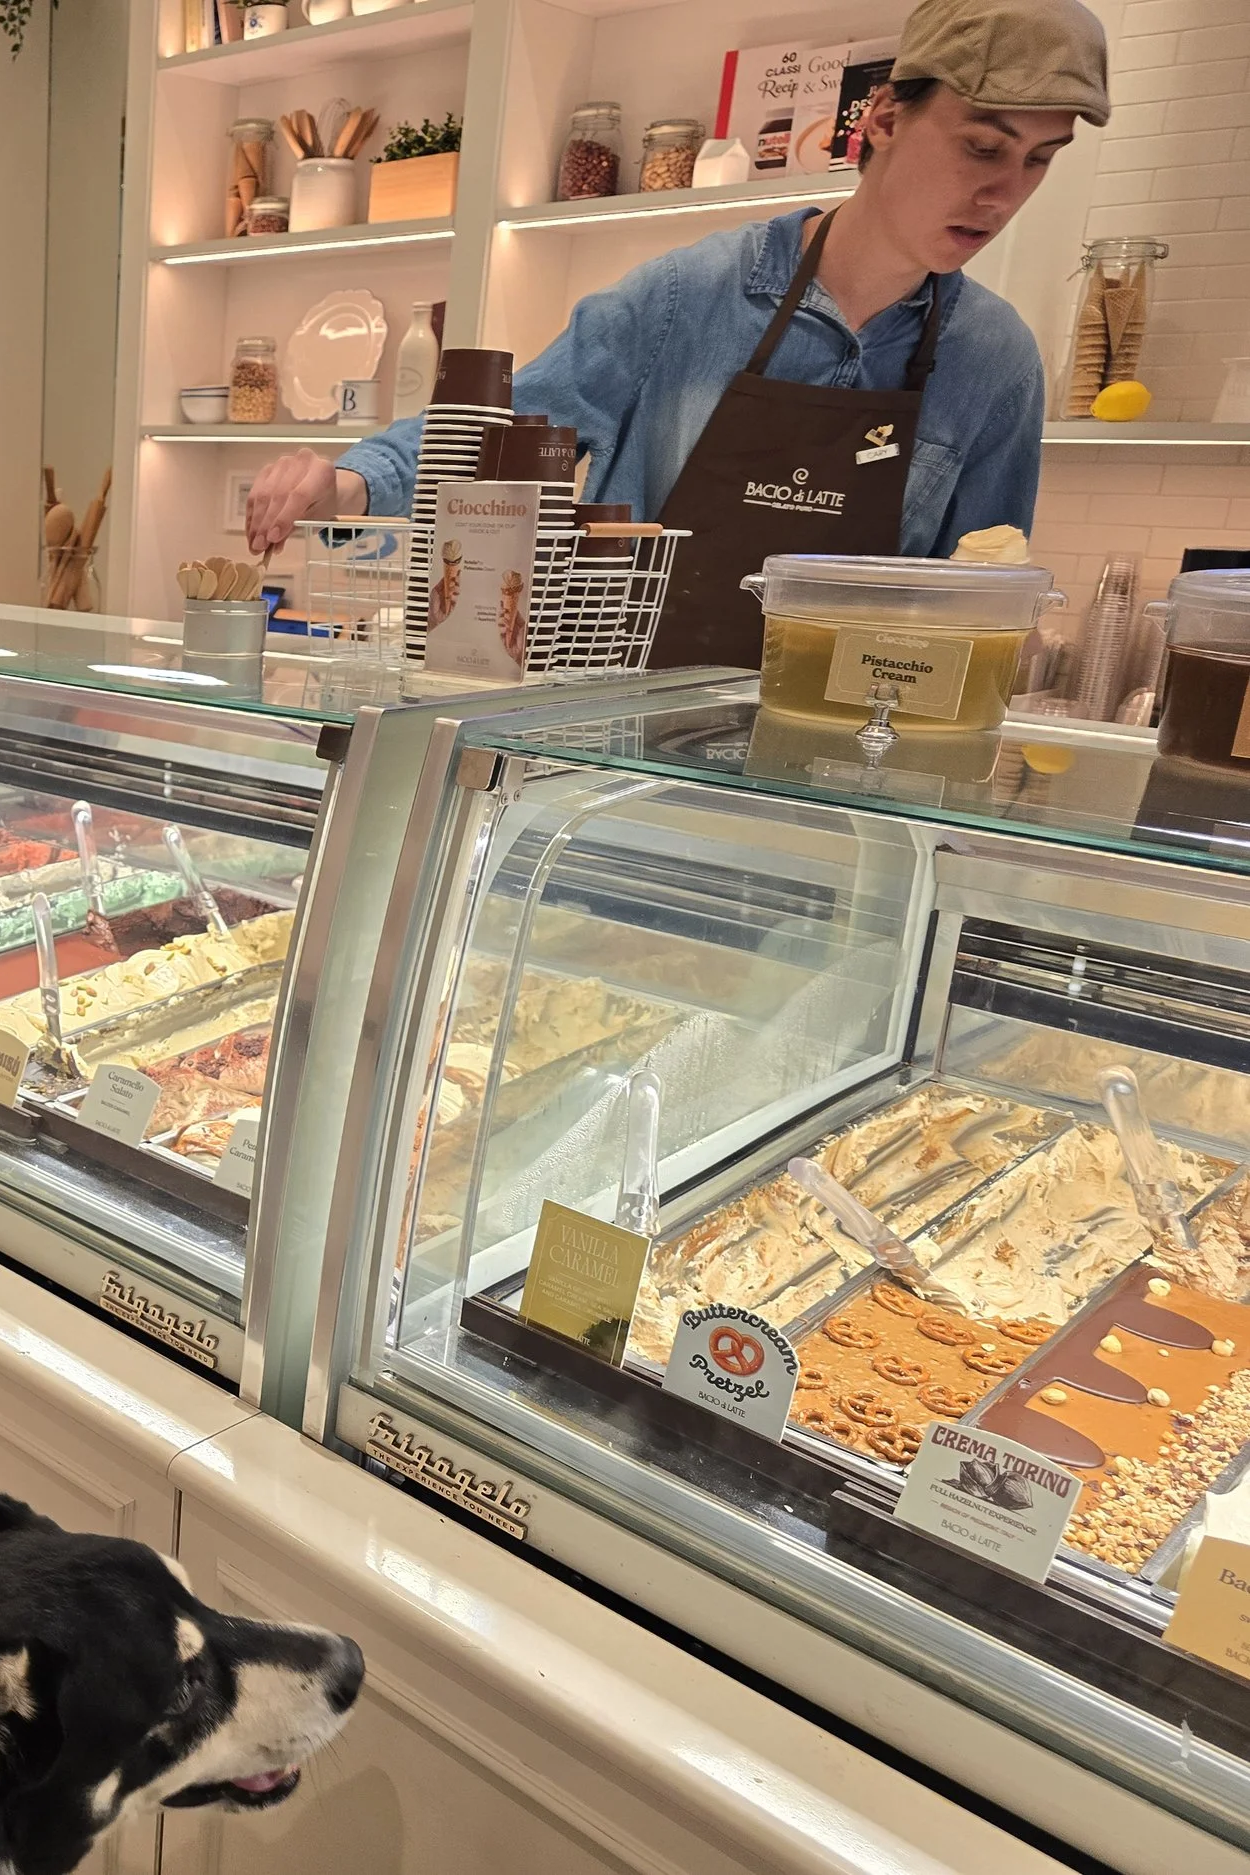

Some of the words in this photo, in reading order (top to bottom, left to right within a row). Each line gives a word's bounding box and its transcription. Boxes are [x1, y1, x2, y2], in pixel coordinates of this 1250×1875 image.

[782, 52, 797, 63] 60
[808, 50, 852, 74] Good
[343, 388, 356, 411] B
[447, 498, 527, 516] Ciocchino
[745, 481, 792, 501] BACIO
[793, 489, 804, 503] di
[806, 490, 846, 508] LATTE
[861, 653, 934, 674] Pistacchio
[872, 667, 918, 684] Cream
[108, 1071, 144, 1092] Caramello
[110, 1083, 133, 1099] Salato
[562, 1225, 618, 1265] VANILLA
[550, 1244, 619, 1288] CARAMEL
[170, 1337, 186, 1352] YOU
[188, 1347, 209, 1364] NEED
[682, 1303, 798, 1376] Buttercream
[689, 1354, 770, 1403] Pretzel
[698, 1390, 720, 1406] BACIO
[727, 1404, 746, 1418] LATTE
[931, 1424, 997, 1465] CREMA
[1002, 1451, 1072, 1499] TORINO
[372, 1448, 391, 1463] THE
[395, 1461, 459, 1502] EXPERIENCE
[462, 1499, 483, 1515] YOU
[488, 1513, 516, 1534] NEED
[929, 1484, 948, 1497] FULL
[948, 1493, 989, 1515] HAZELNUT
[988, 1508, 1037, 1536] EXPERIENCE
[941, 1519, 969, 1538] BACIO
[977, 1536, 1003, 1553] LATTE
